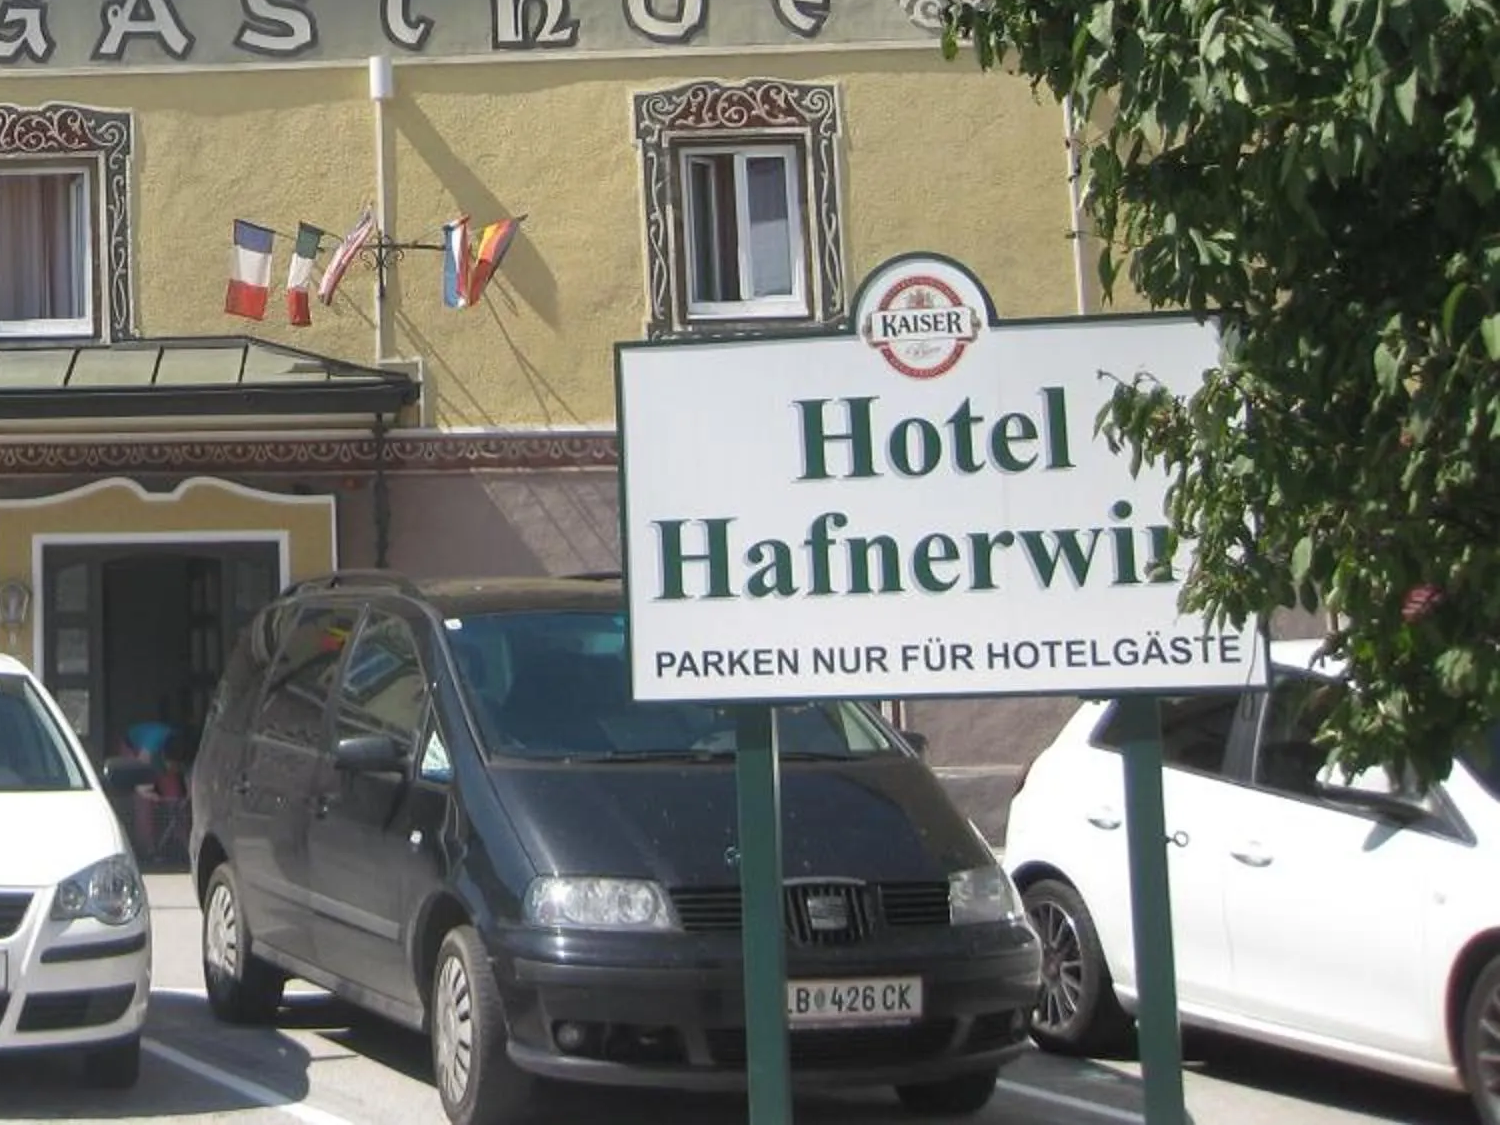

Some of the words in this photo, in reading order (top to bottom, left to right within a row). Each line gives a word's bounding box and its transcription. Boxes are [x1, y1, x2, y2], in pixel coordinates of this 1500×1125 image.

[882, 311, 962, 337] KAISER
[793, 386, 1076, 481] Hotel
[650, 500, 1180, 601] Hafnerwir
[656, 649, 798, 678] PARKEN
[812, 645, 887, 674] NUR
[900, 636, 973, 672] FÜR
[987, 630, 1241, 669] HOTELGÄSTE
[830, 986, 875, 1012] 426
[882, 984, 911, 1010] CK
